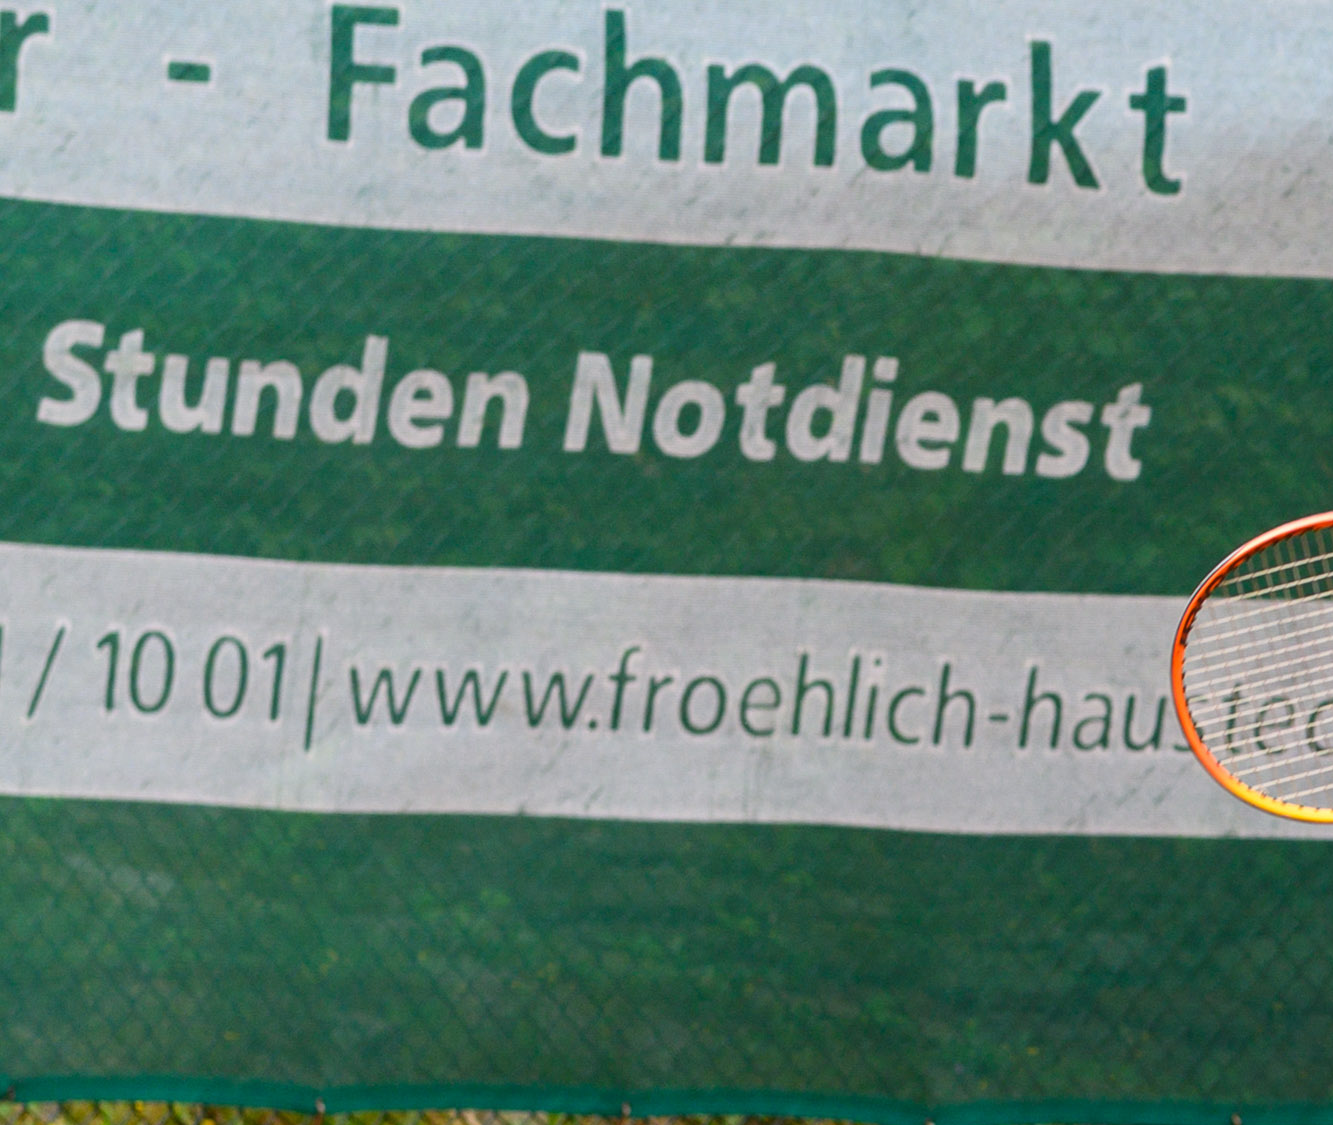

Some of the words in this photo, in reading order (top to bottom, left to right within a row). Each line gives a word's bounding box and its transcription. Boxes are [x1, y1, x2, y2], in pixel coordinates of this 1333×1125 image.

[167, 61, 211, 83] -
[327, 4, 1187, 196] Fachmarkt
[37, 320, 530, 449] Stunden
[564, 352, 1151, 481] Notdienst
[97, 631, 175, 714] 10
